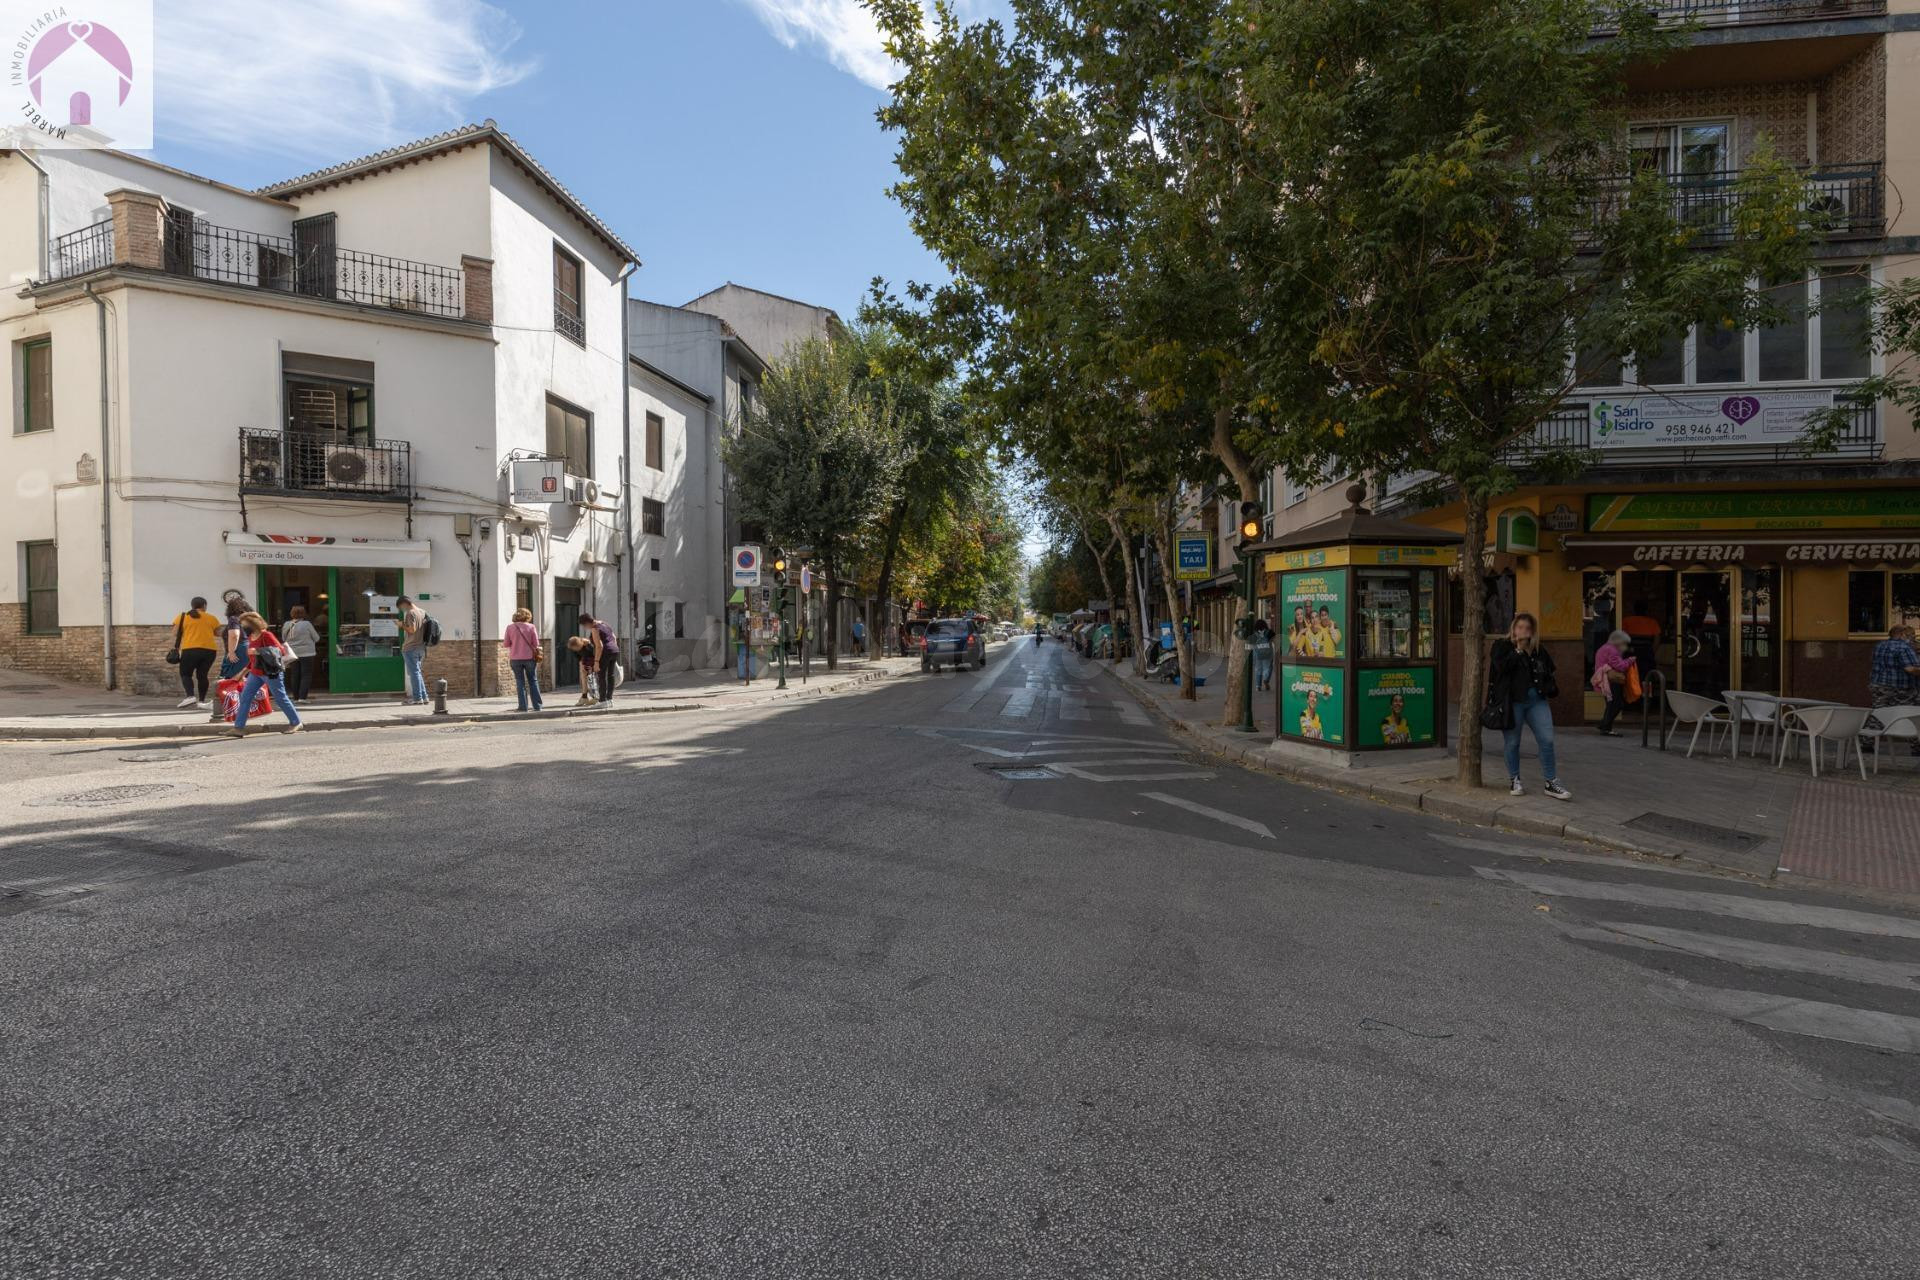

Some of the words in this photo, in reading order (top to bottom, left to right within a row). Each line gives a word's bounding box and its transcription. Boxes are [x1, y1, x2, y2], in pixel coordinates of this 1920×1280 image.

[1613, 405, 1639, 417] San
[1613, 418, 1655, 431] Isidro
[1665, 425, 1687, 436] 958
[1691, 424, 1712, 435] 946
[1715, 423, 1736, 434] 421
[239, 550, 247, 558] la
[248, 551, 273, 560] gracia
[275, 551, 285, 559] de
[286, 551, 304, 560] Dios
[1633, 545, 1746, 562] CAFETERIA
[1786, 542, 1920, 560] CERVECERIA
[1286, 594, 1316, 603] JUGAMOS
[1316, 593, 1339, 602] TODOS
[1368, 687, 1401, 697] JUGAMOS
[1402, 686, 1426, 695] TODOS
